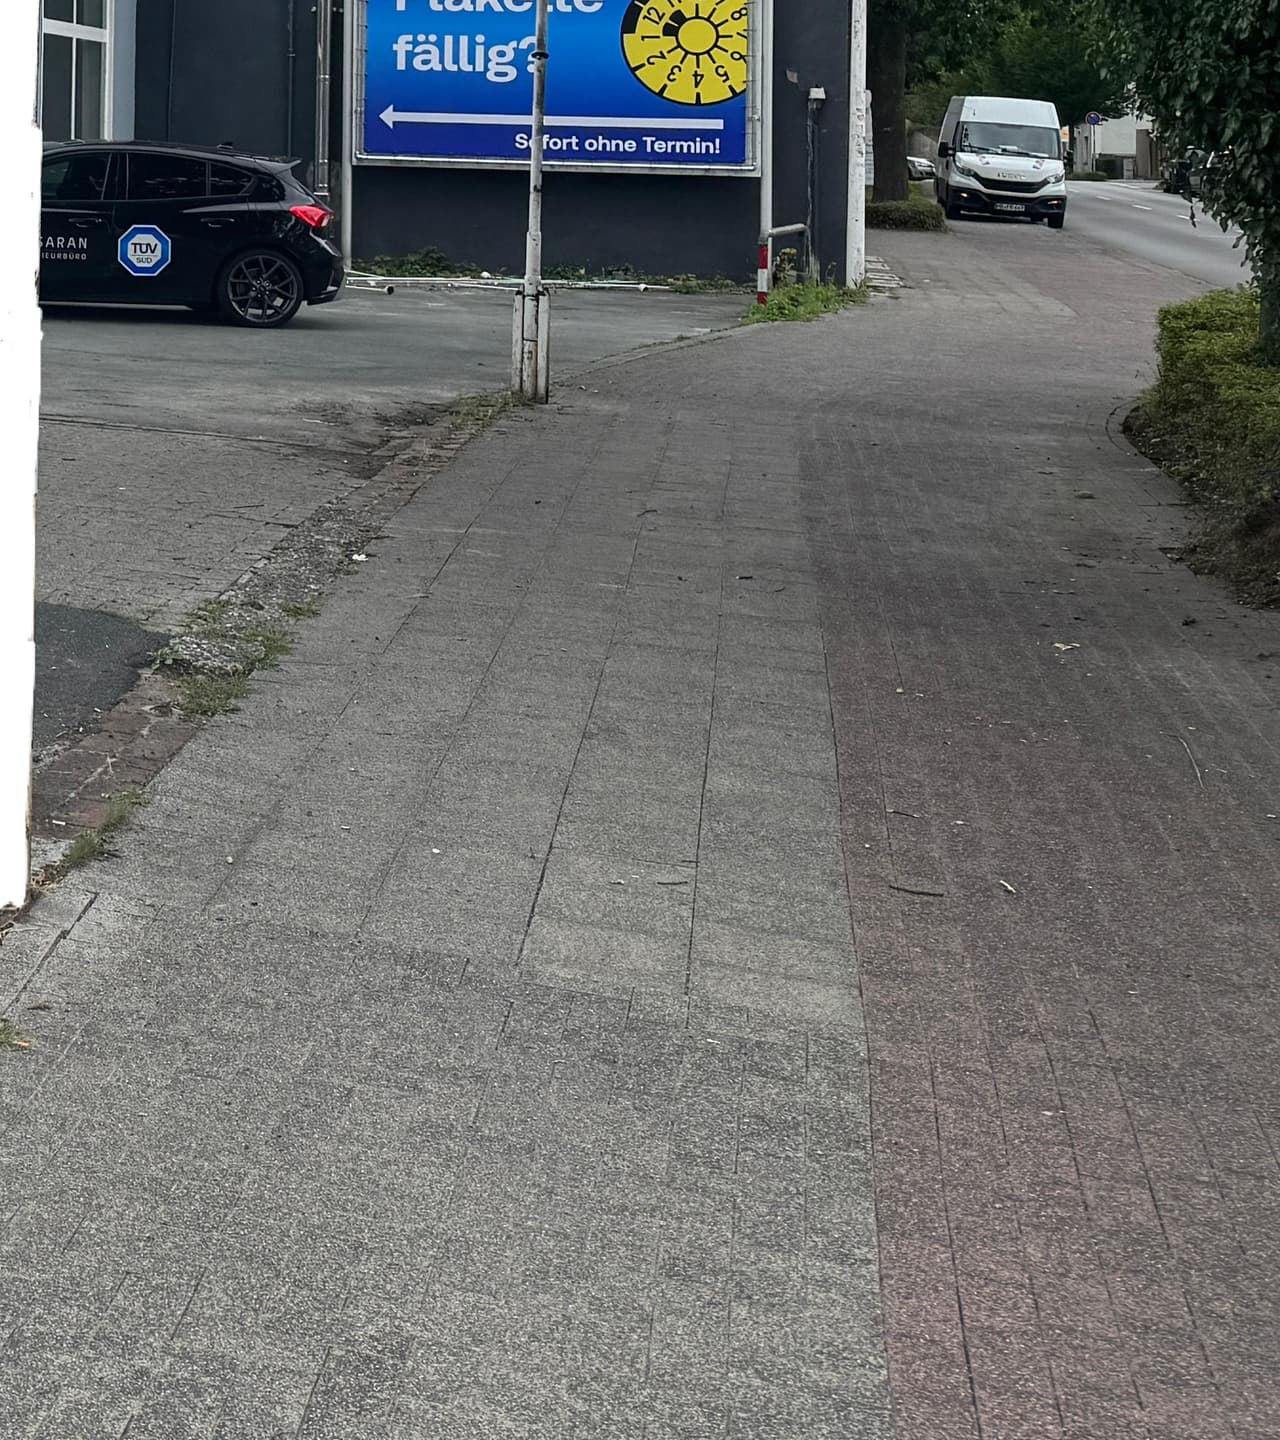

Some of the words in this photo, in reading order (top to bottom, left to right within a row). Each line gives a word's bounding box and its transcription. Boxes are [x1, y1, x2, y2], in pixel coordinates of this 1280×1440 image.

[643, 7, 665, 25] 12
[731, 7, 748, 20] 8
[647, 51, 668, 65] 2
[667, 65, 682, 82] 3
[692, 70, 704, 88] 4
[715, 65, 730, 83] 5
[514, 133, 579, 151] Sfort
[584, 136, 637, 152] ohne
[642, 136, 720, 154] Termin!
[131, 242, 158, 254] TÜV
